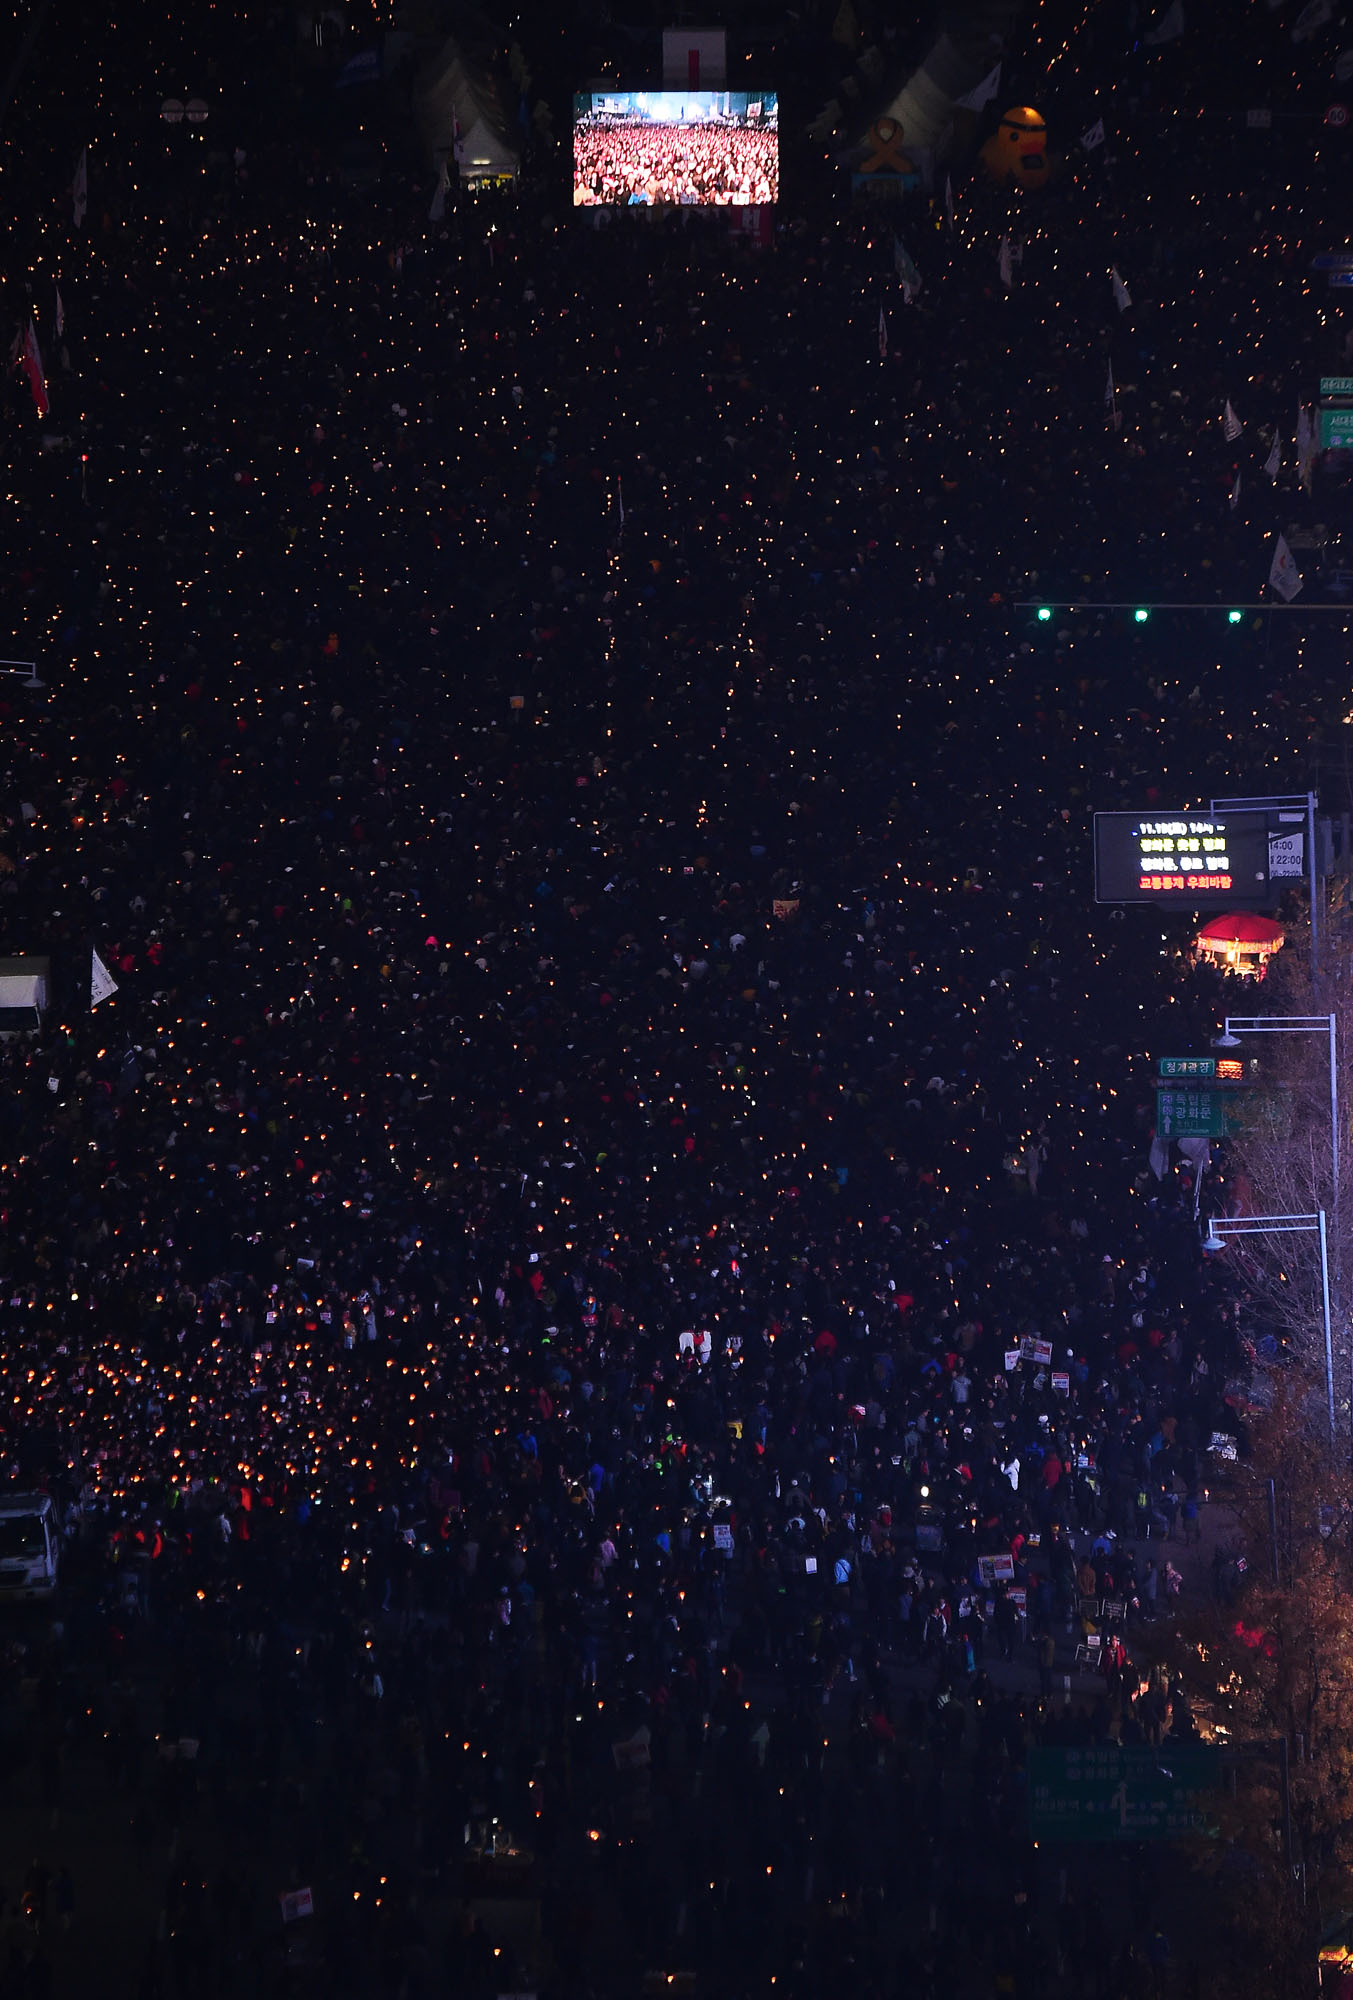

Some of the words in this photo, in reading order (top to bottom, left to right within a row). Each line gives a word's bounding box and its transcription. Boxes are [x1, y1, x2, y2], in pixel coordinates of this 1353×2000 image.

[1139, 875, 1185, 890] 교통통제
[1187, 875, 1232, 889] 우회바람
[1166, 1062, 1210, 1073] 청계광장
[1175, 1107, 1211, 1119] 광화문
